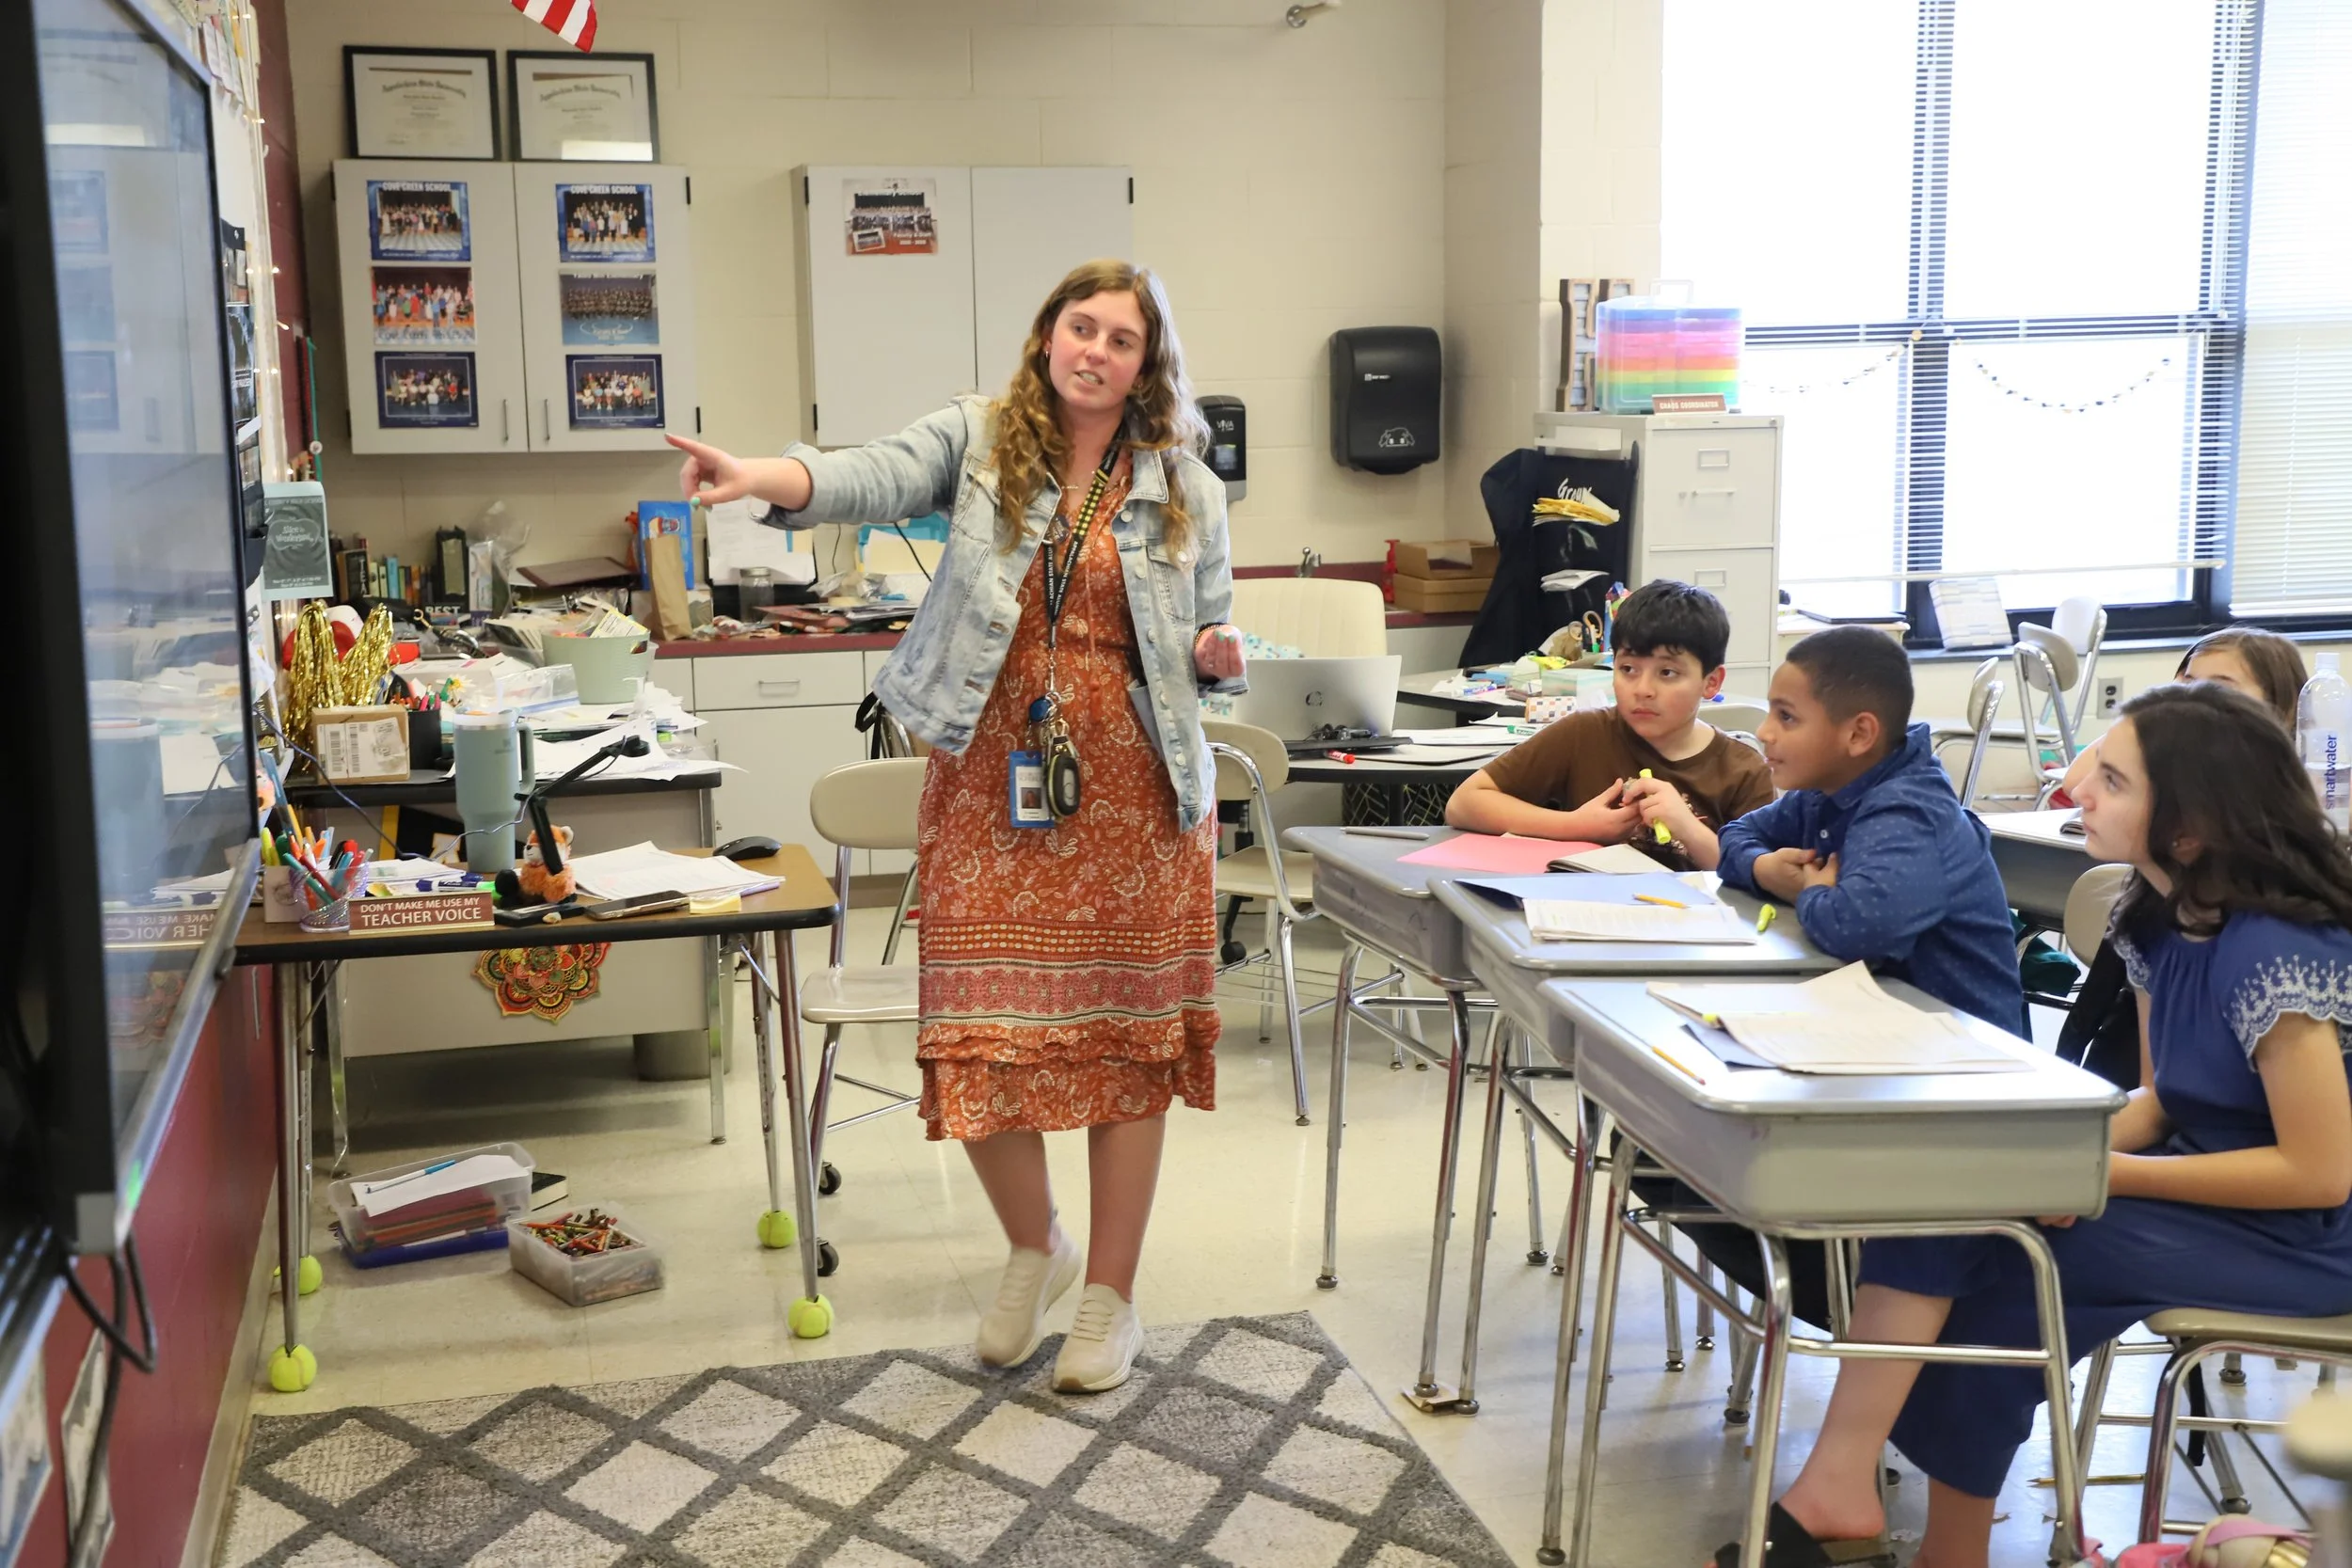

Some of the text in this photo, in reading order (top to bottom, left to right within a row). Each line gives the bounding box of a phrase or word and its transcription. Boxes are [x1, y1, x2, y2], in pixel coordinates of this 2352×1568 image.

[424, 182, 452, 192] SCHOOL
[612, 185, 638, 195] SCHOOL
[1058, 578, 1069, 594] STATE
[2324, 735, 2337, 810] smartwater
[360, 896, 480, 913] DON'T MAKE ME USE MY
[361, 907, 482, 927] TEACHER VOICE
